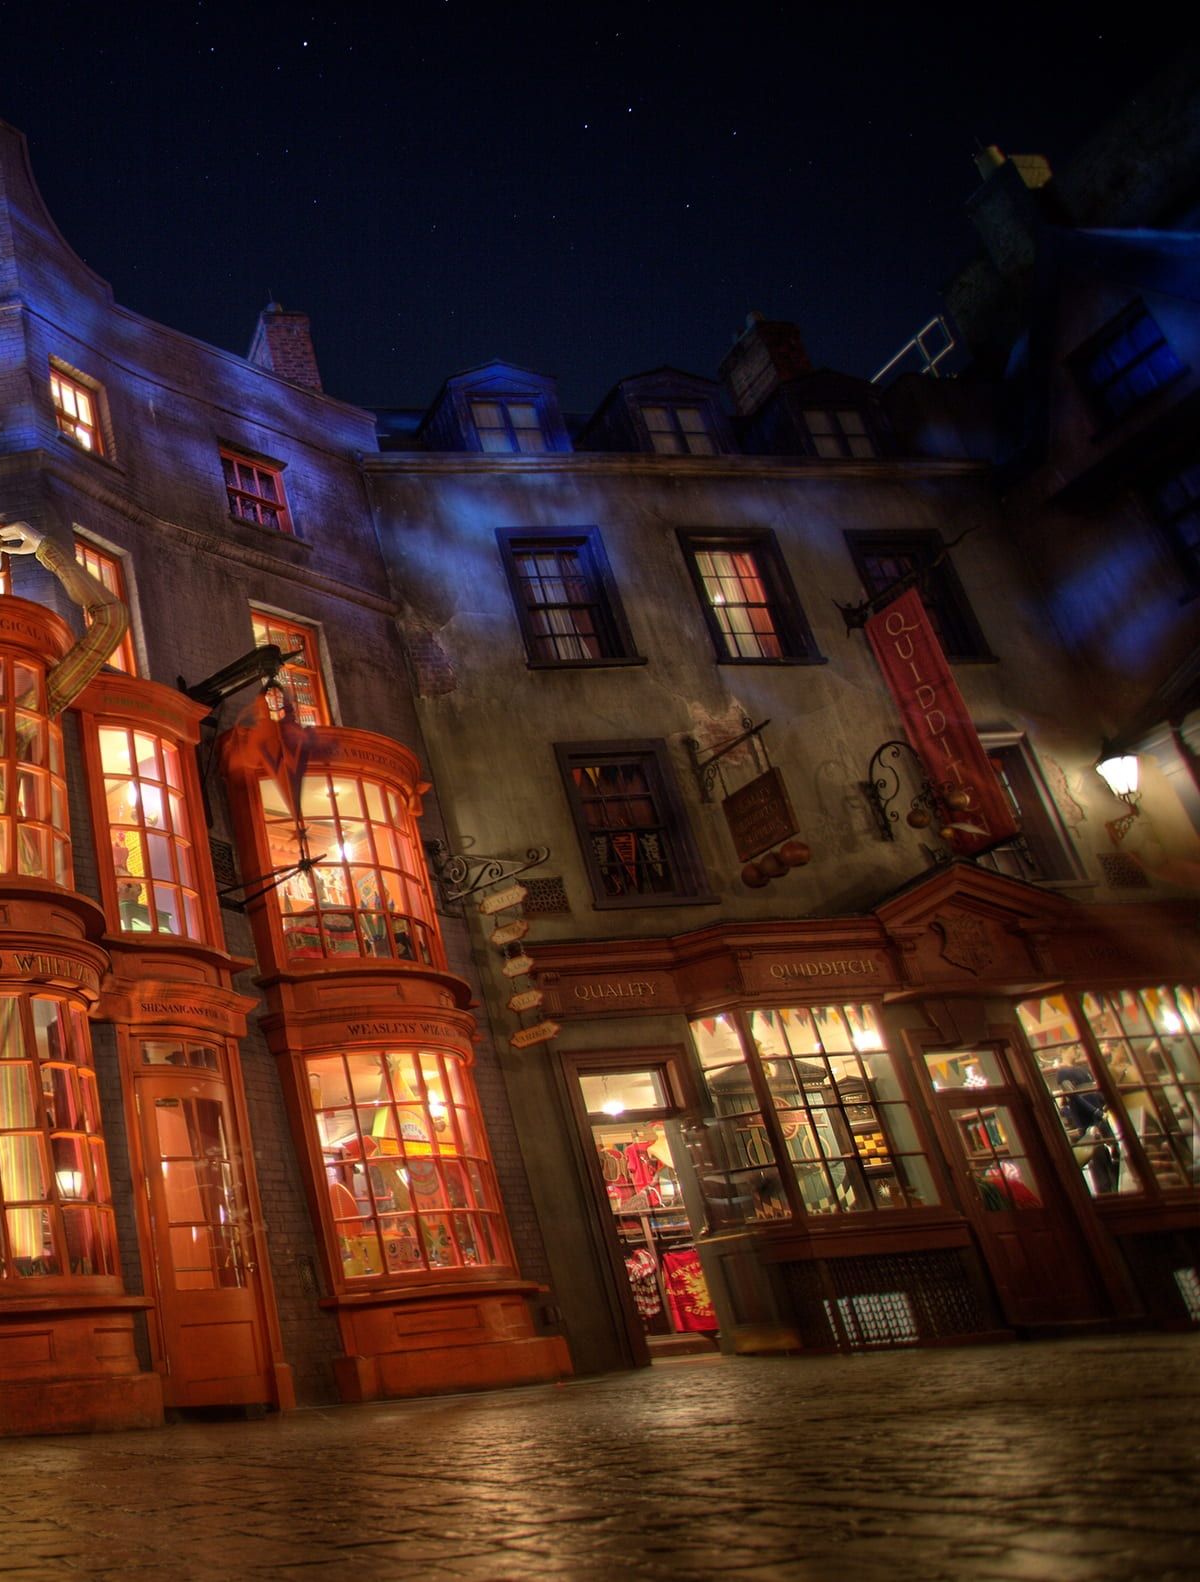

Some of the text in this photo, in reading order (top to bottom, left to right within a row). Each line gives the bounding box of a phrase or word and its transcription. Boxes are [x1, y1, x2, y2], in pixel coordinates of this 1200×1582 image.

[14, 953, 94, 984] WHEEZE
[770, 959, 876, 979] QUIDDITCH
[574, 982, 656, 1000] QUALITY
[347, 1023, 417, 1036] WEASLEYS'
